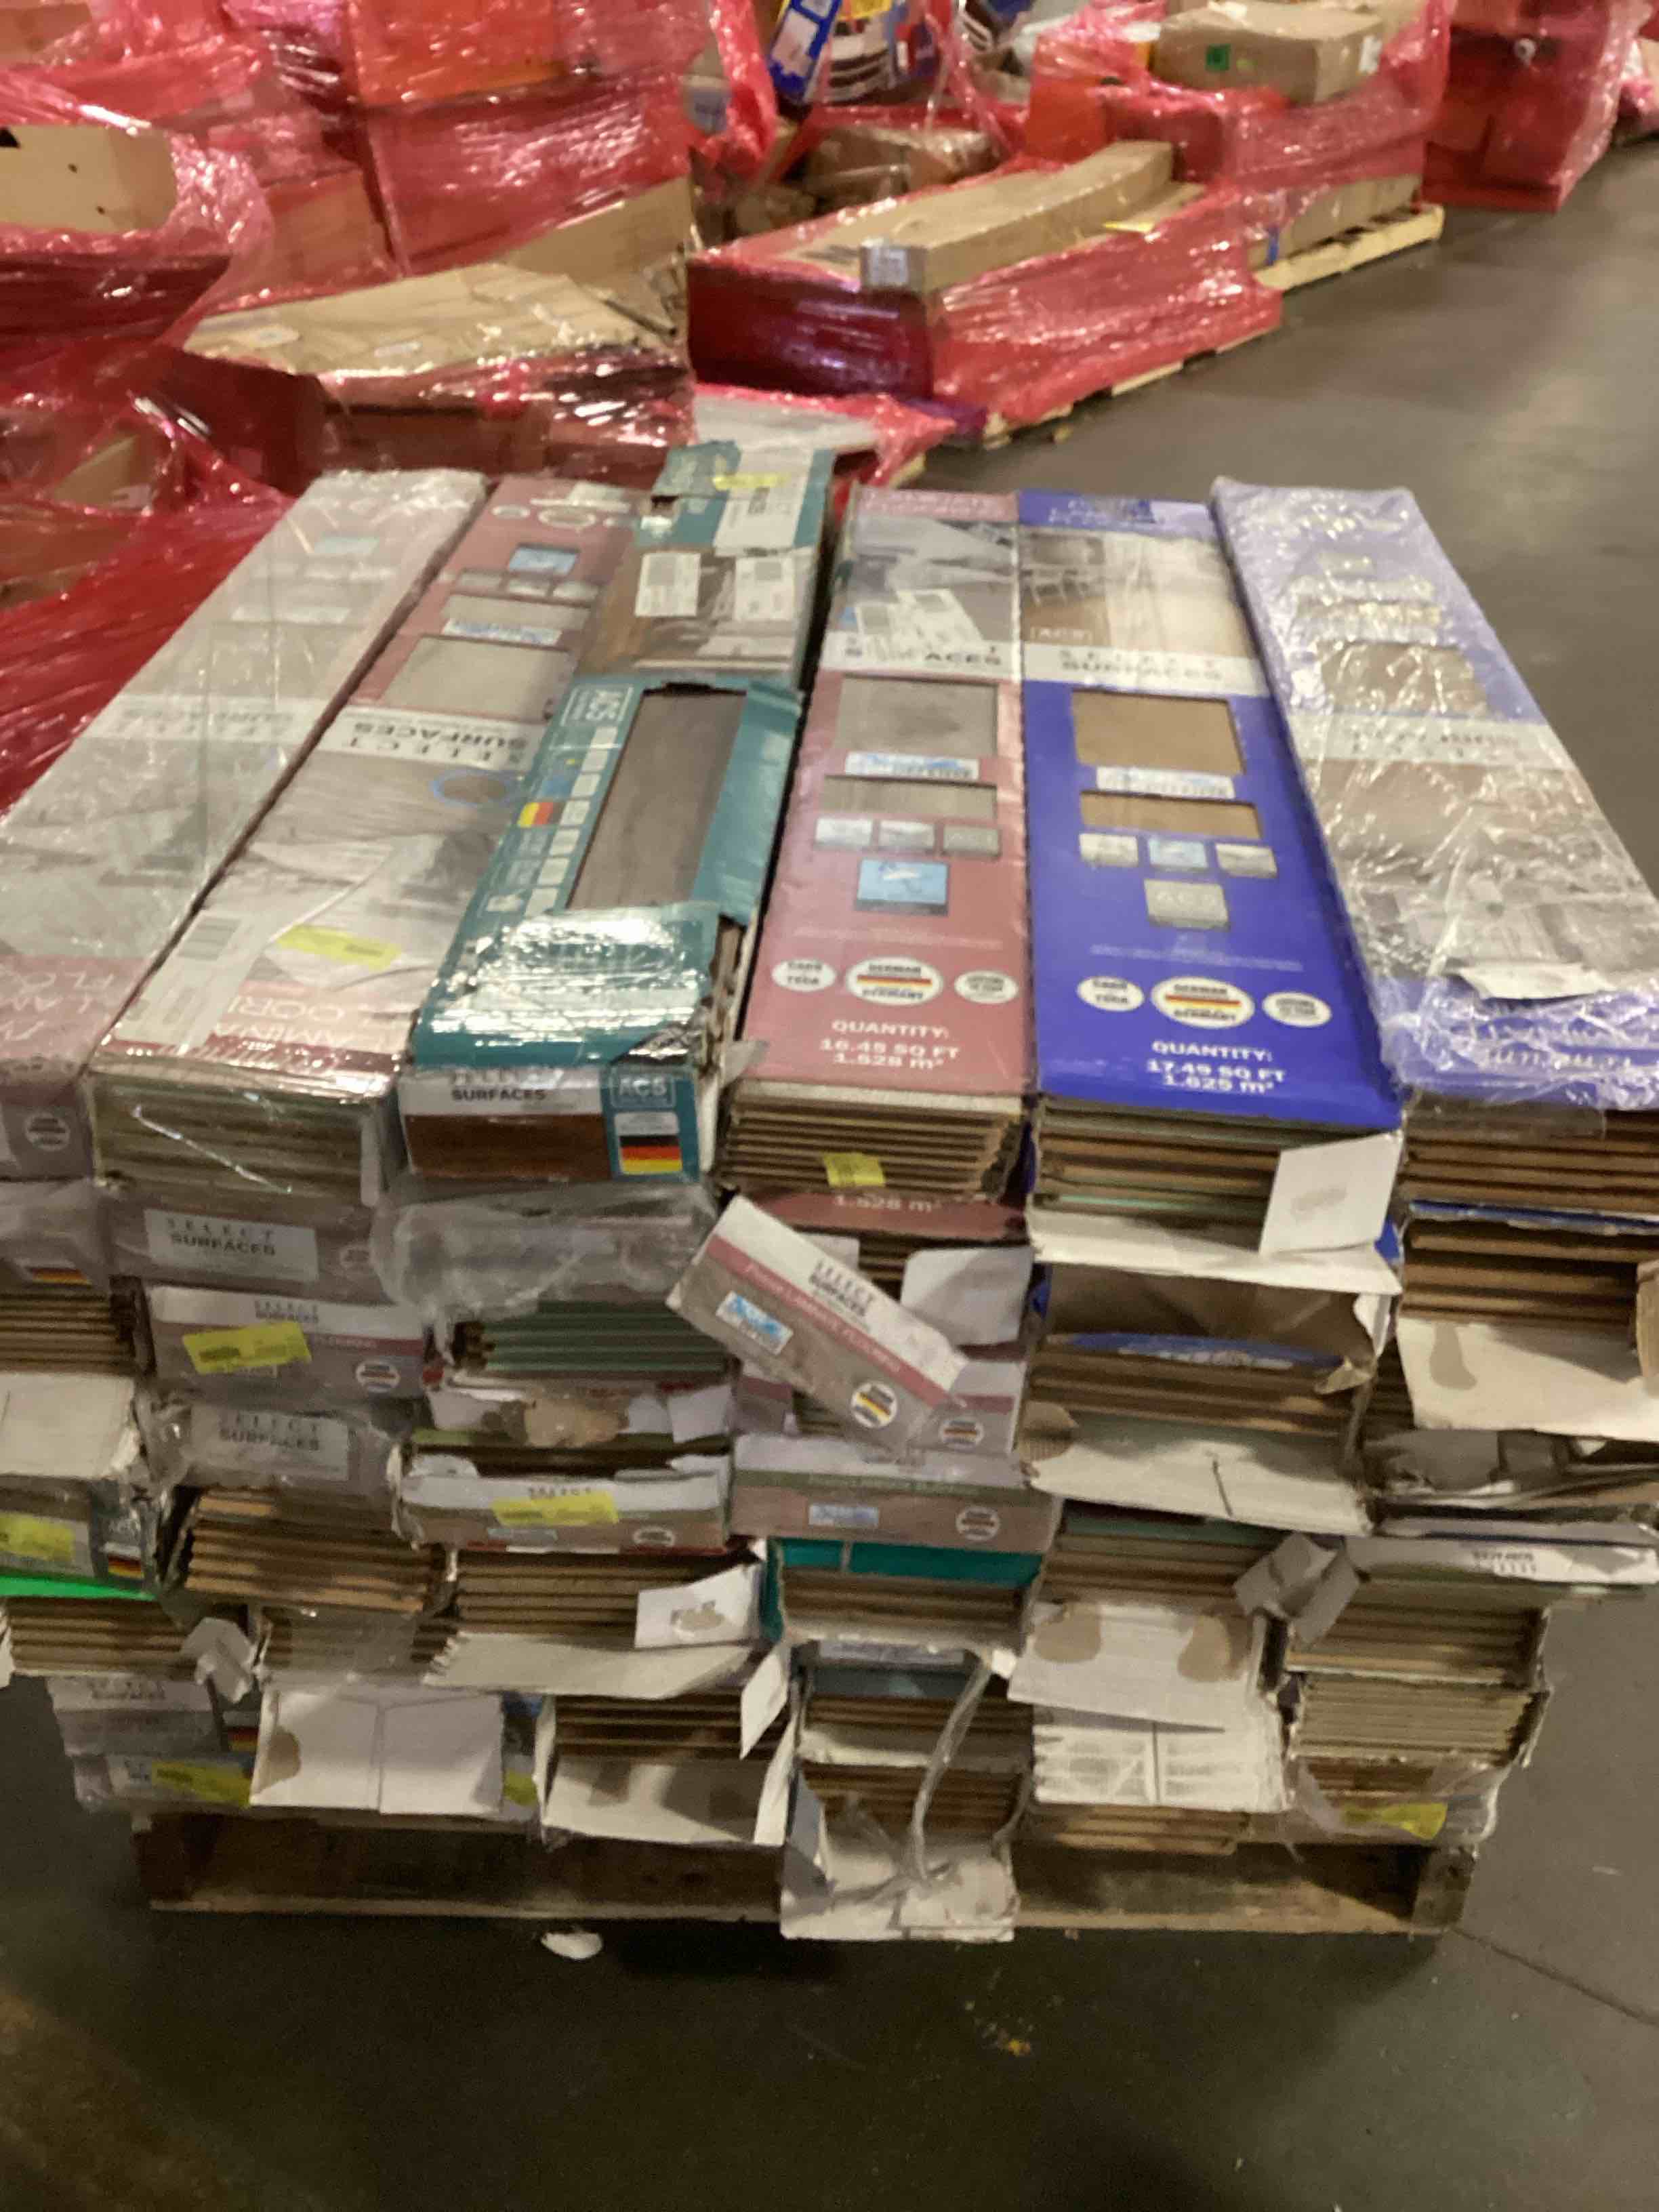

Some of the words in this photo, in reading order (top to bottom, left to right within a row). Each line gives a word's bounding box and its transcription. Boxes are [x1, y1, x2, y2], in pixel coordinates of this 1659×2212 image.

[831, 1019, 949, 1039] QUANTITY:
[893, 1043, 926, 1059] SQ
[931, 1045, 960, 1060] FT
[1151, 1039, 1274, 1062] QUANTITY:
[1217, 1062, 1252, 1080] SQ
[1257, 1067, 1286, 1082] FT
[451, 1087, 546, 1103] SURFACES
[171, 1231, 276, 1256] SURFACES
